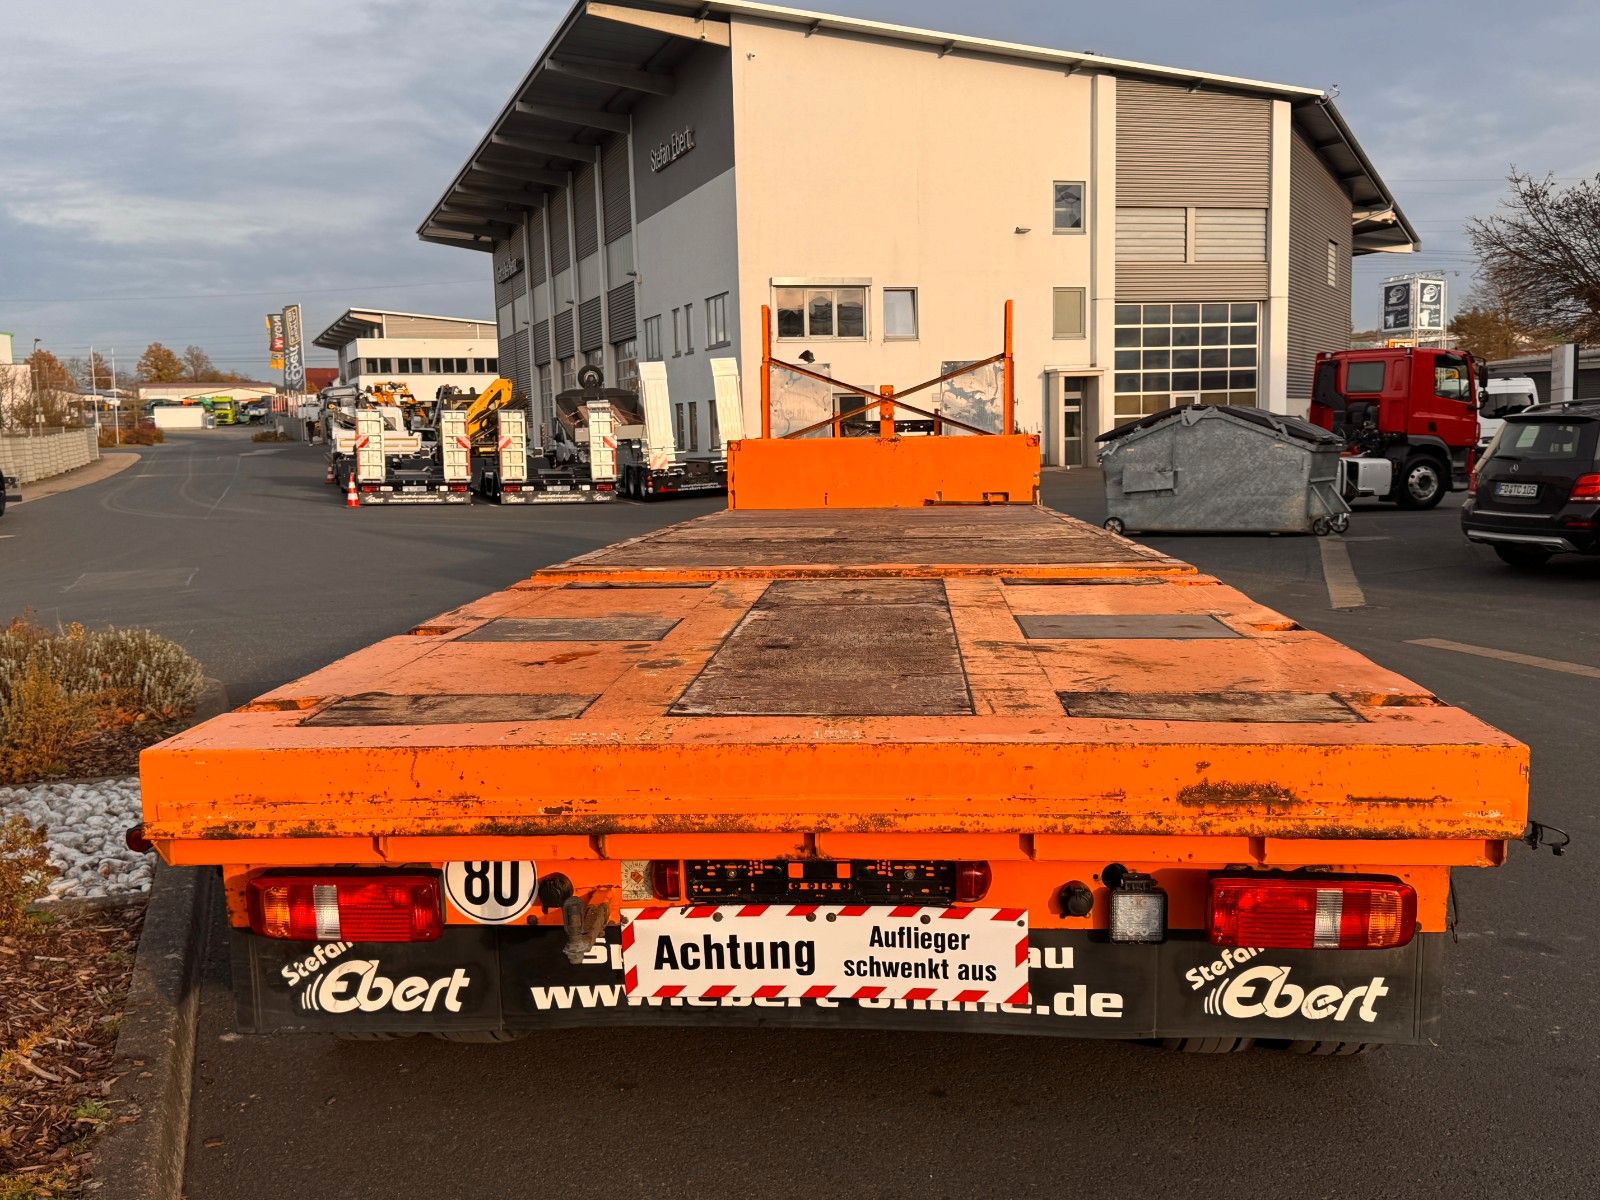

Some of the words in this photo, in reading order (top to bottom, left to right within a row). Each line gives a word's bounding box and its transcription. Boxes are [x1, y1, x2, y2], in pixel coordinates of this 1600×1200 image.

[650, 143, 671, 172] Stefan
[671, 126, 695, 160] Ebert
[1523, 485, 1536, 495] 105
[464, 861, 520, 907] 80
[654, 934, 816, 976] Achtung
[869, 925, 970, 954] Auflieger
[318, 959, 471, 1013] Ebert
[843, 956, 949, 980] schwenkt
[957, 962, 997, 982] aus
[1222, 965, 1389, 1023] Ebert
